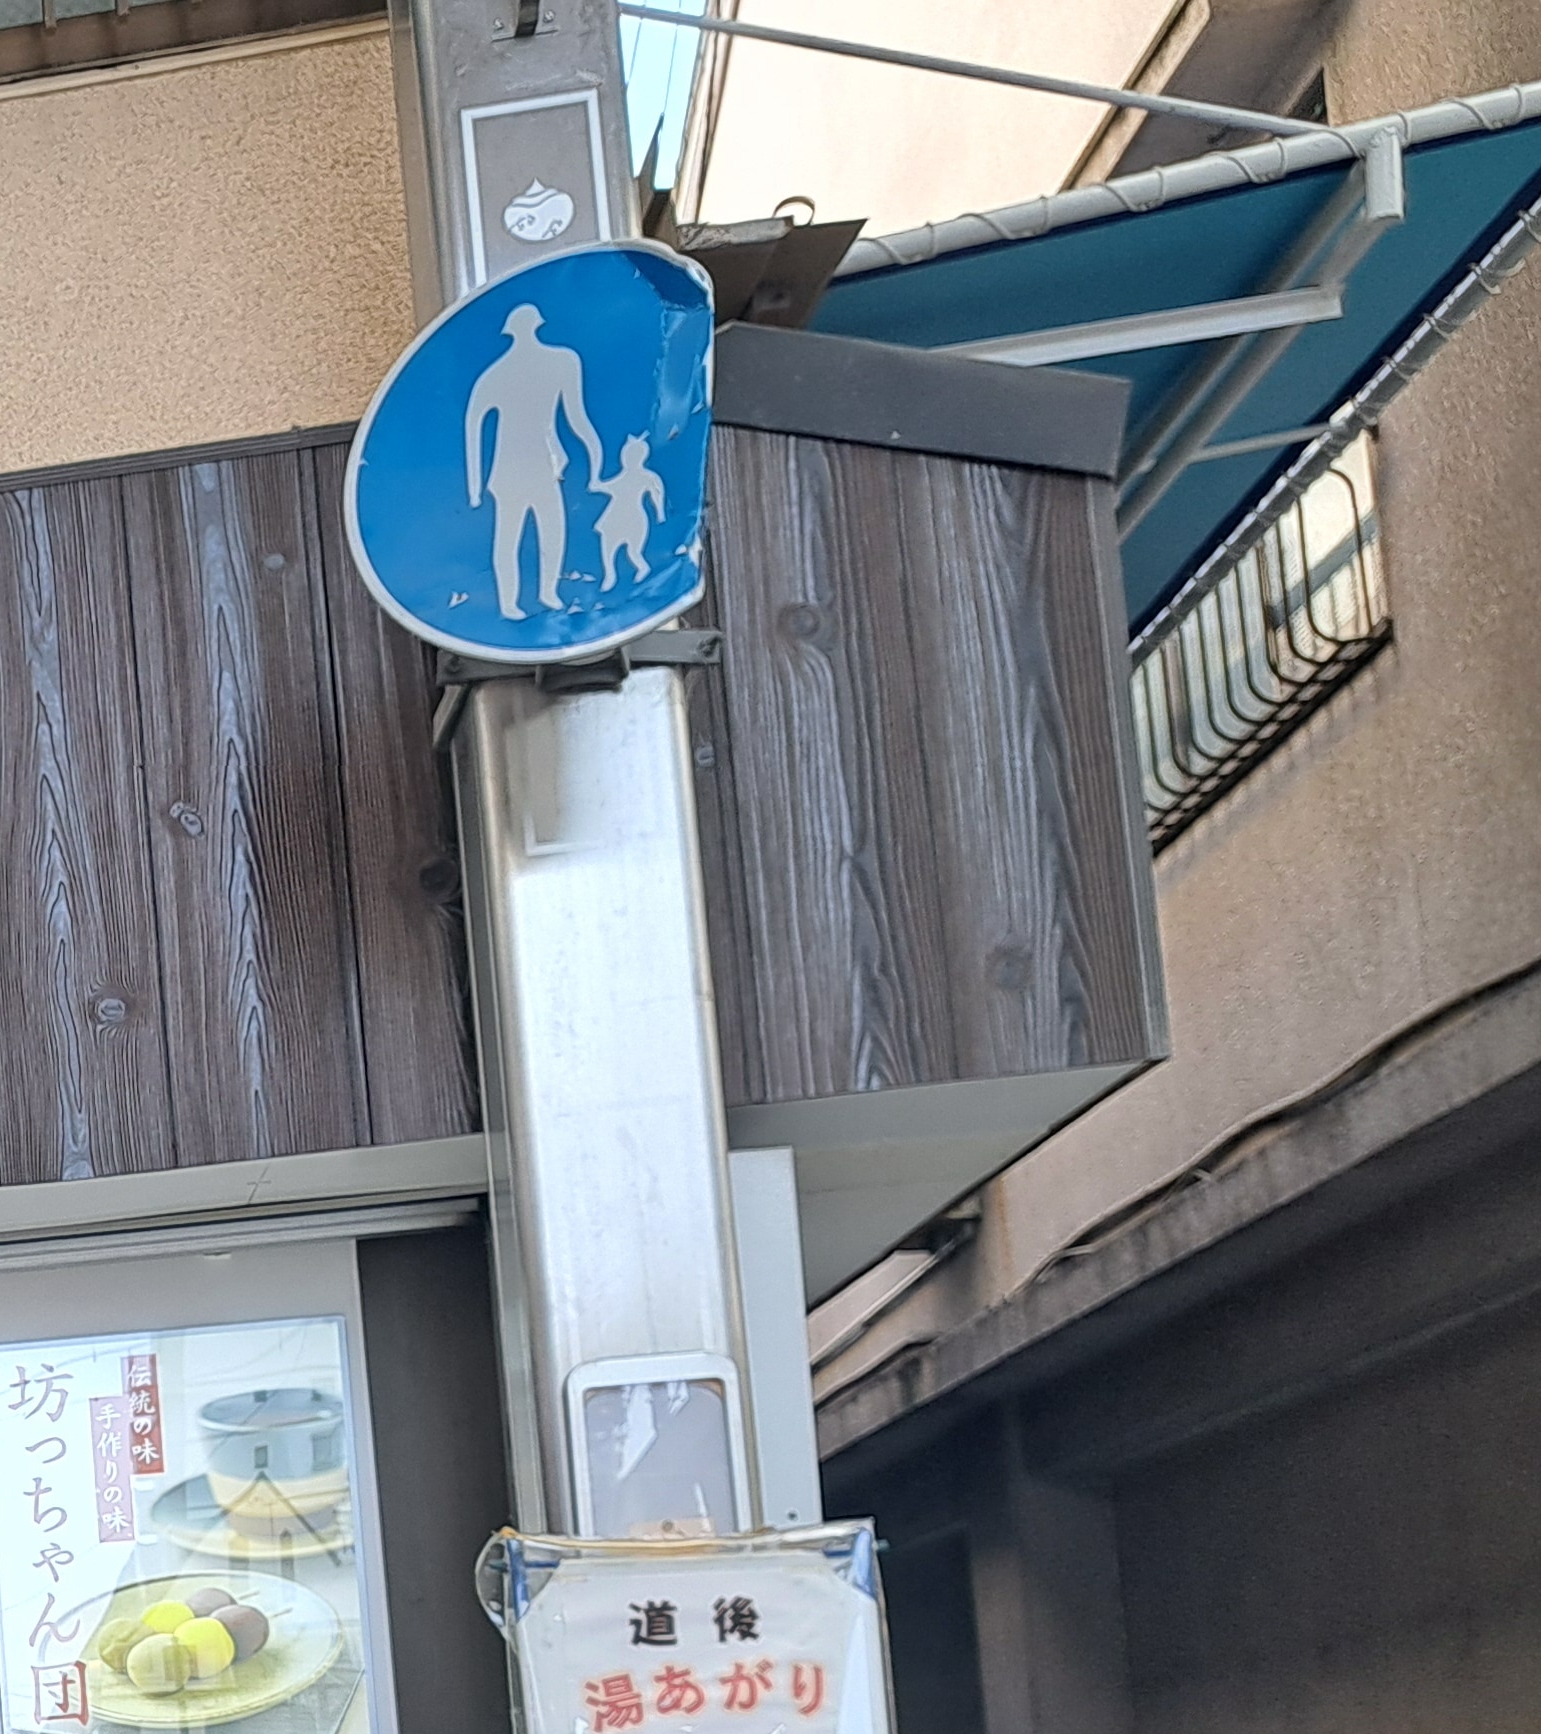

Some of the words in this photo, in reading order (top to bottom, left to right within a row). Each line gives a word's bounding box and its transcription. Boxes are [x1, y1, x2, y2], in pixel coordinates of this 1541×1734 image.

[125, 1362, 159, 1466] 伝統の味
[95, 1403, 132, 1534] 手作りの味
[628, 1596, 762, 1647] 道後
[584, 1661, 826, 1734] 湯あがり
